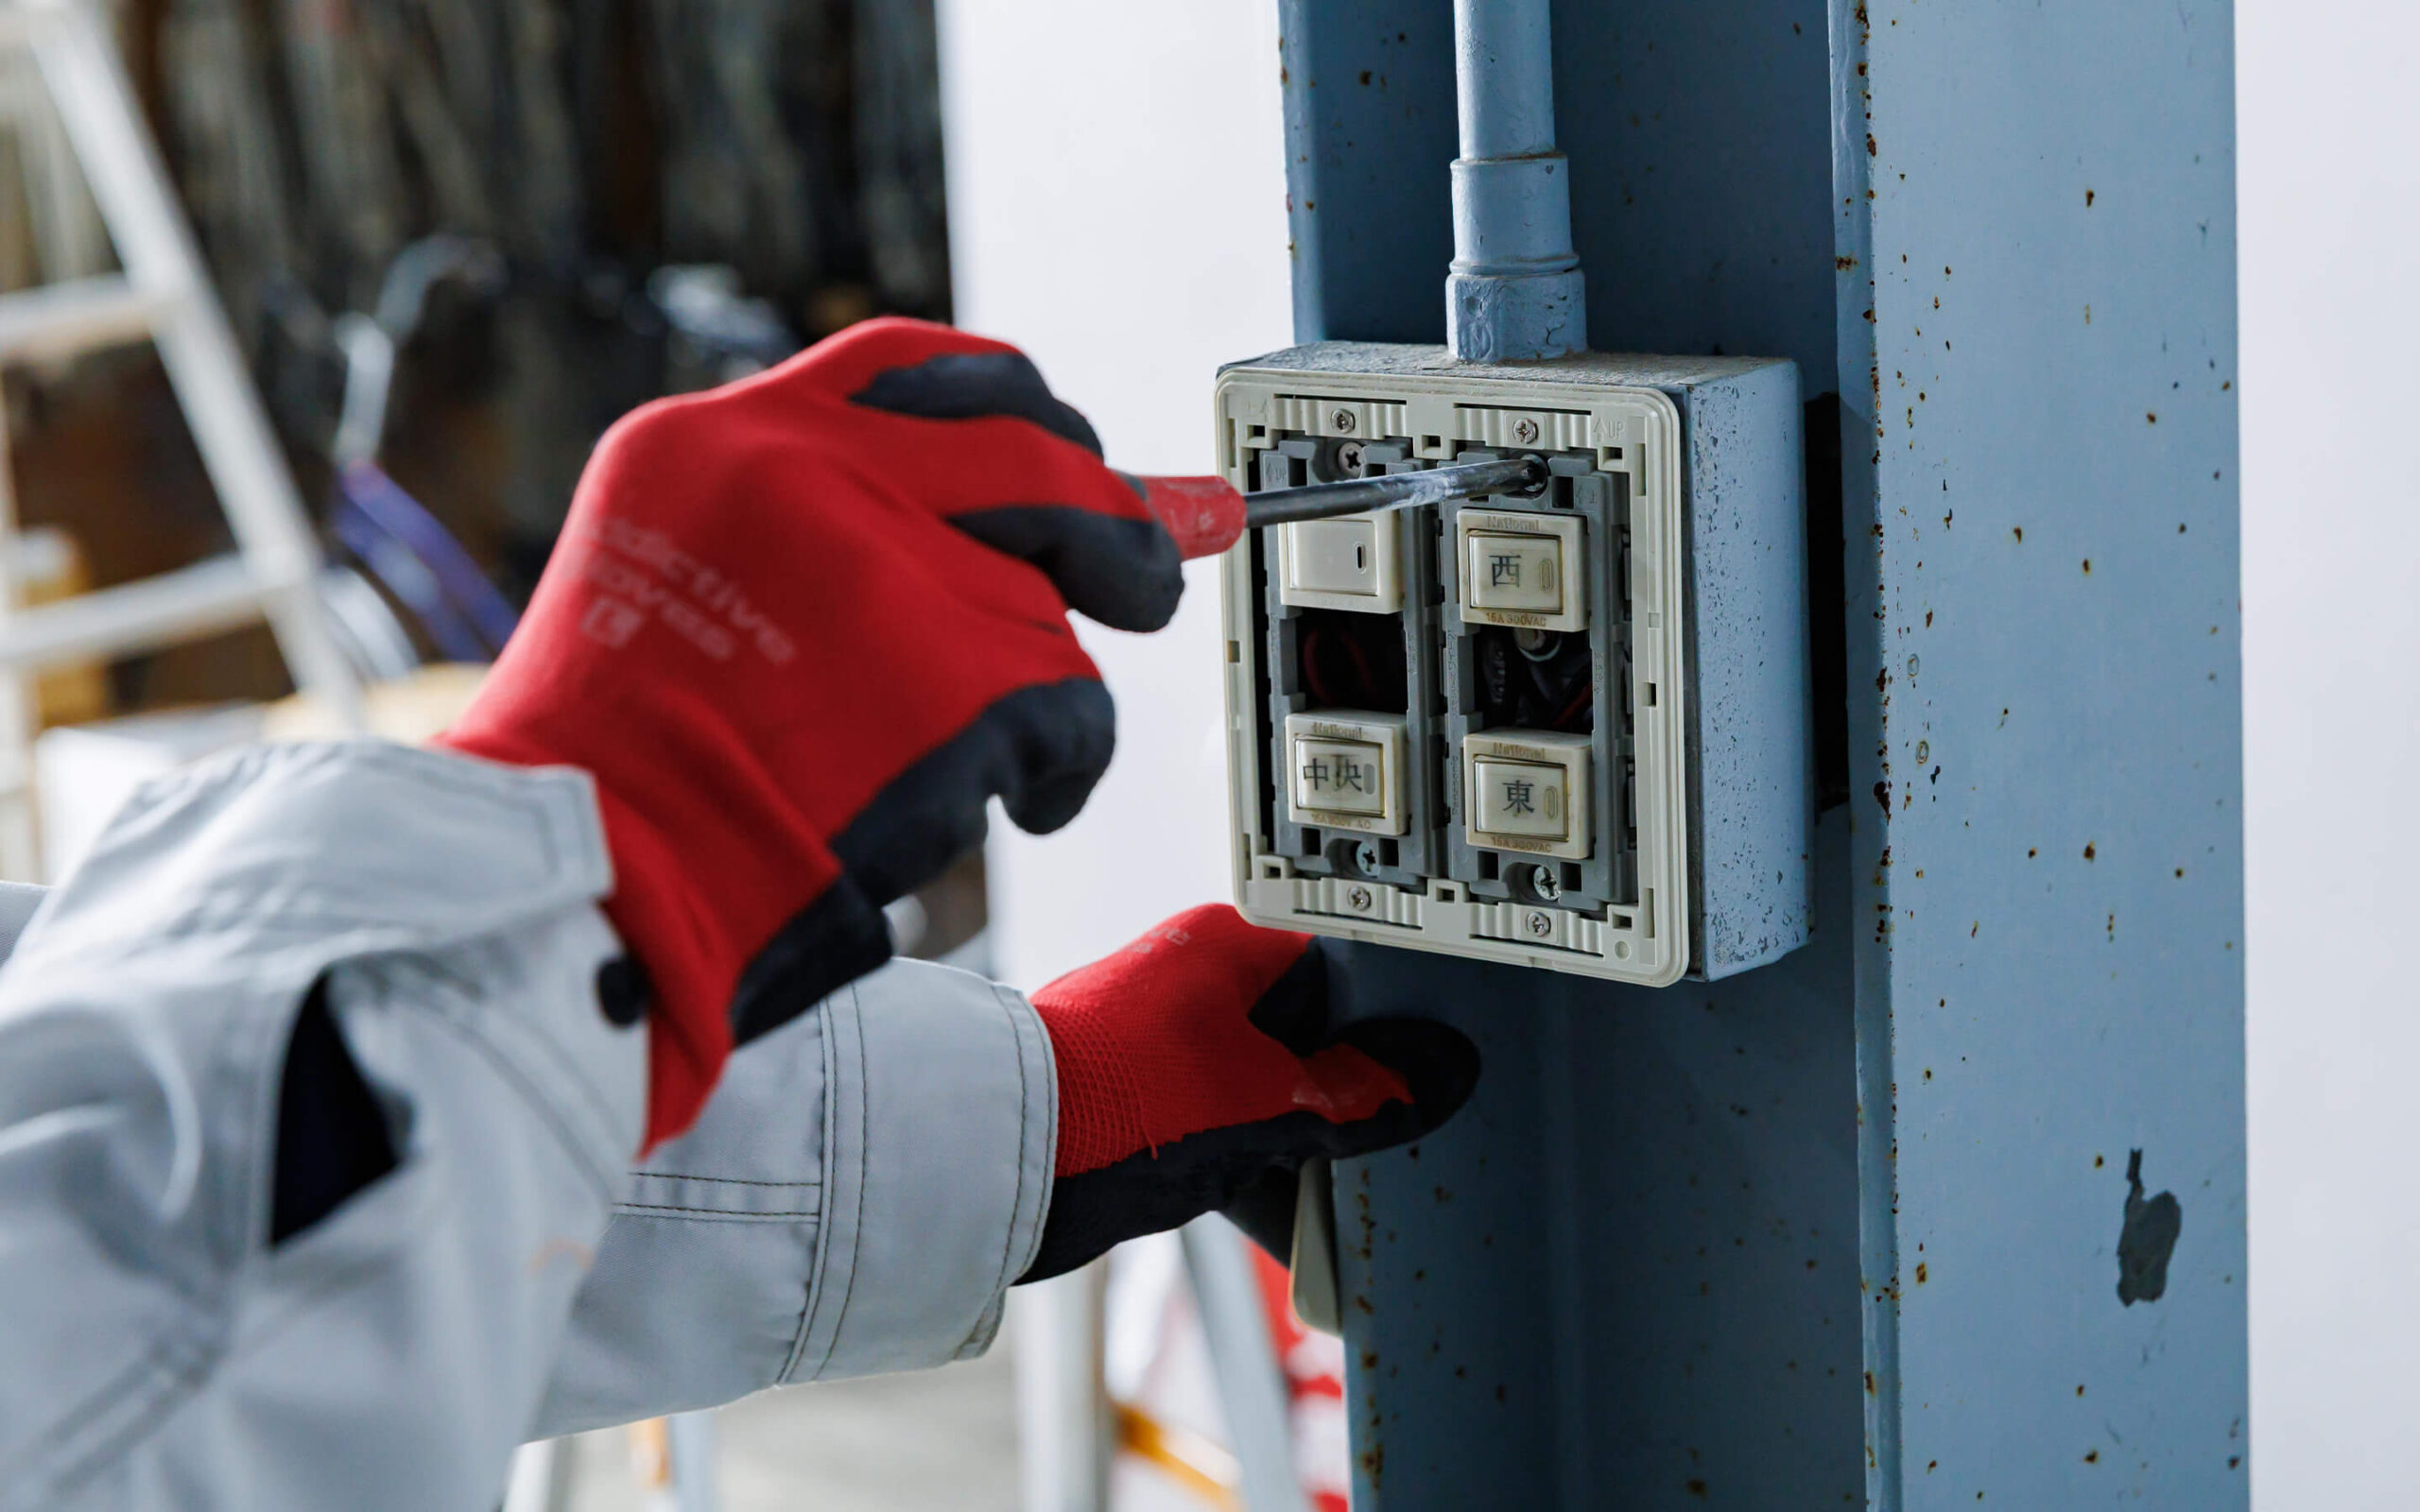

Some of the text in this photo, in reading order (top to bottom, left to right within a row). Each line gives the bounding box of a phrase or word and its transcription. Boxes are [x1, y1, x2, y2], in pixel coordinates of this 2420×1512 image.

[1608, 419, 1624, 439] UP
[1487, 516, 1540, 532] National
[1489, 555, 1521, 588] 西
[1486, 611, 1505, 624] 15A
[1311, 722, 1362, 739] National
[1493, 743, 1546, 760] National
[1303, 758, 1362, 792] 中央
[1502, 780, 1535, 813] 東
